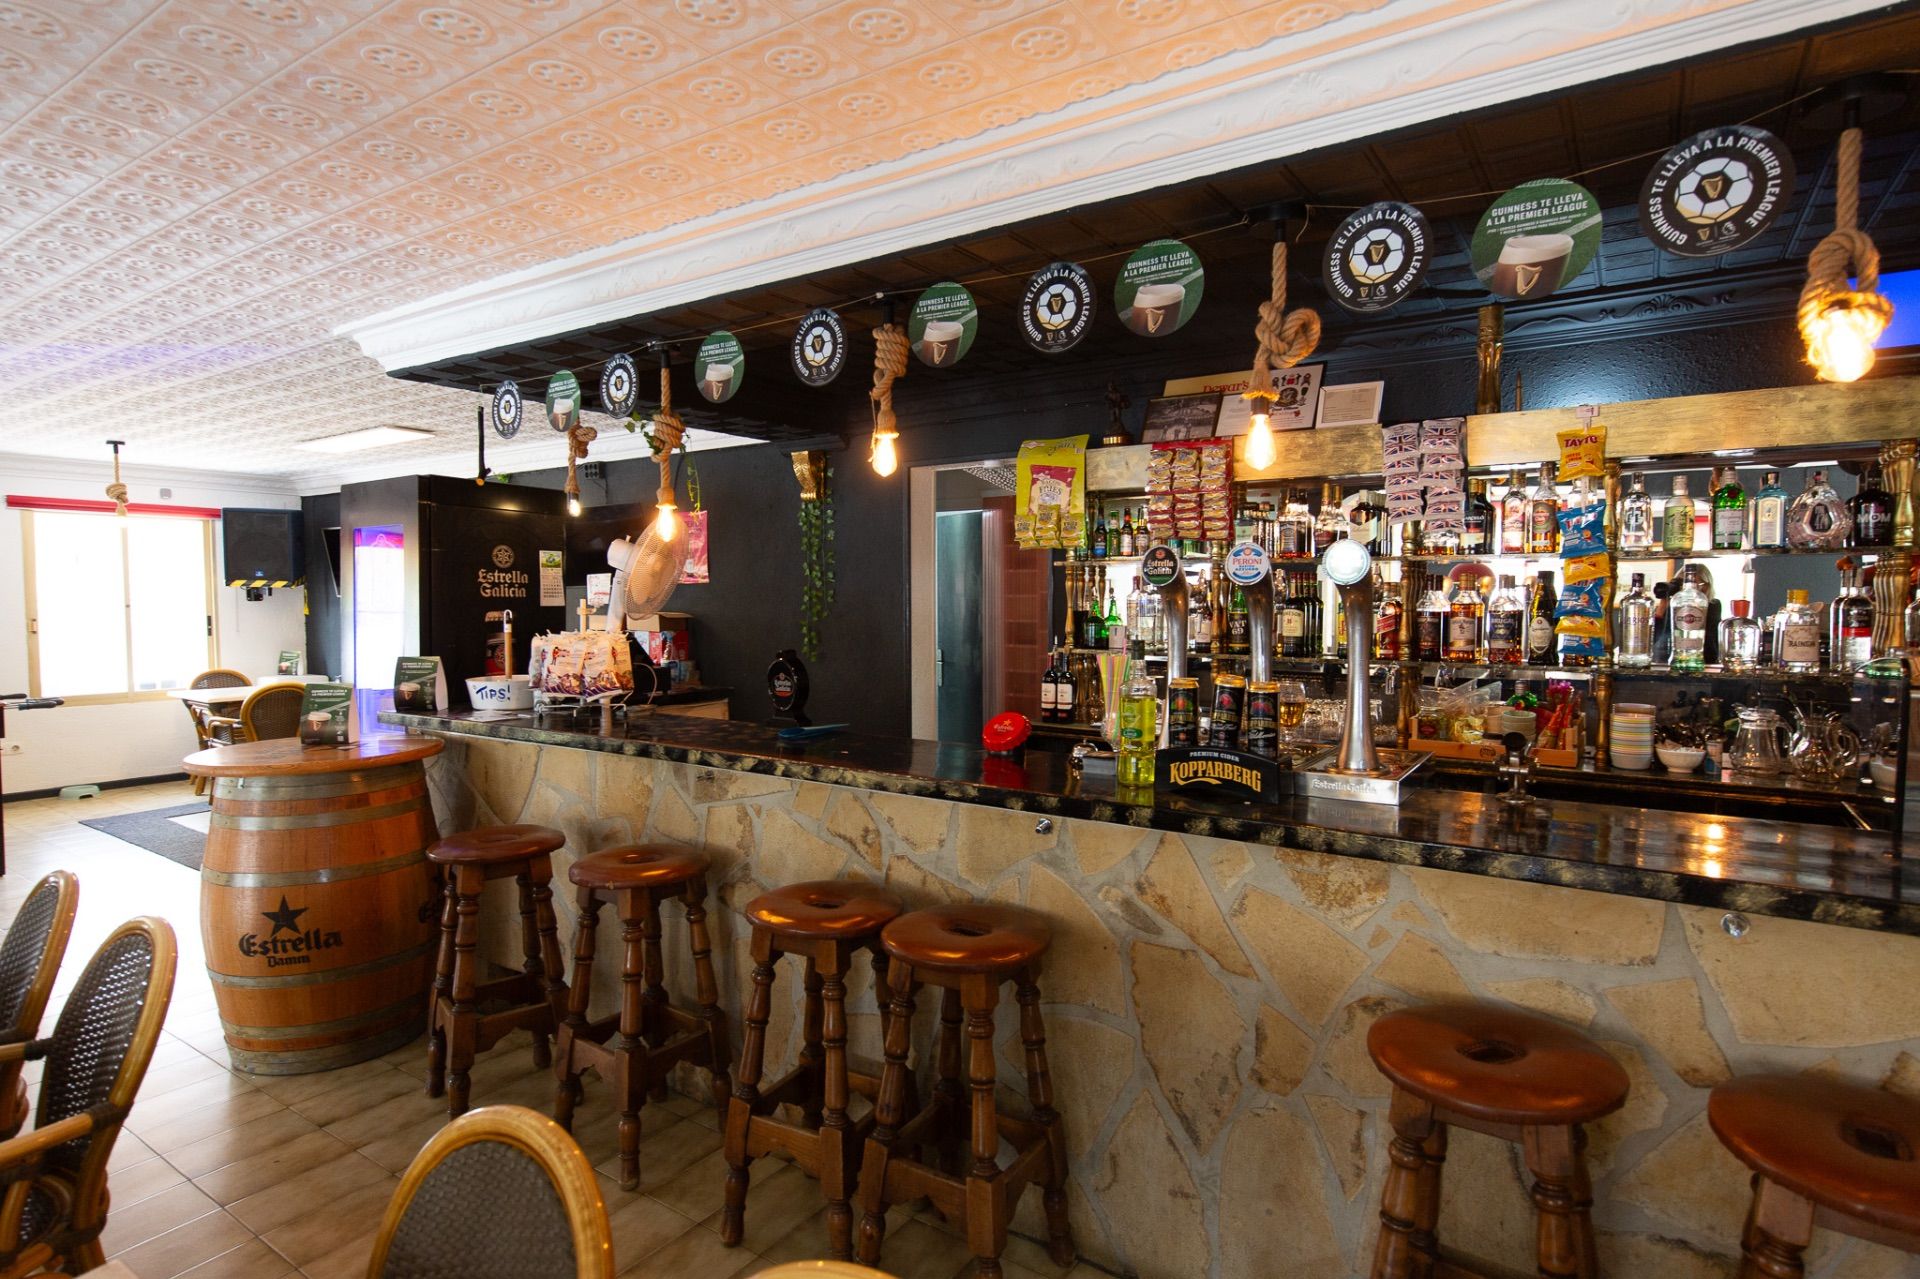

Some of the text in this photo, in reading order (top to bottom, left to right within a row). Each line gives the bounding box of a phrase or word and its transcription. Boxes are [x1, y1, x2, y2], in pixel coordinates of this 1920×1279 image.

[1703, 139, 1713, 150] A
[1716, 135, 1734, 148] LA
[1661, 145, 1700, 178] LLEVA
[1737, 136, 1782, 179] PREMIER
[1651, 178, 1667, 193] TE
[1492, 192, 1584, 217] GUINNESS TE LLEVA
[1745, 179, 1782, 228] LEAGUE
[1486, 201, 1588, 227] A LA PREMIER LEAGUE
[1649, 197, 1688, 245] GUINNESS
[1127, 257, 1159, 269] GUINNESS
[1169, 251, 1190, 261] LLEVA
[1330, 210, 1424, 298] GUINNESS TE LLEVA A LA PREMIER LEAGUE
[1060, 269, 1069, 277] LA
[1139, 263, 1167, 275] PREMIER
[1168, 257, 1194, 268] LEAGUE
[1031, 272, 1052, 292] LLEVA
[1069, 271, 1091, 304] PREMIER
[919, 297, 944, 307] GUINNESS
[951, 293, 967, 301] LLEVA
[951, 299, 970, 308] LEAGUE
[1025, 292, 1034, 303] TE
[799, 317, 814, 334] LLEVA
[826, 316, 843, 343] PREMIER
[1023, 304, 1042, 342] GUINNESS
[1070, 305, 1090, 337] LEAGUE
[795, 335, 802, 344] TE
[794, 346, 809, 377] GUINNESS
[829, 345, 843, 372] LEAGUE
[1564, 435, 1598, 448] TAYTO
[1857, 513, 1892, 523] MOM
[478, 568, 529, 584] Estrella
[480, 583, 527, 597] Galicia
[1229, 620, 1247, 628] VAT
[1231, 627, 1244, 635] 69
[1220, 752, 1240, 762] CIDER
[1169, 760, 1262, 792] KOPPARBERG
[238, 928, 344, 957] Estrella
[267, 955, 310, 968] Damm
